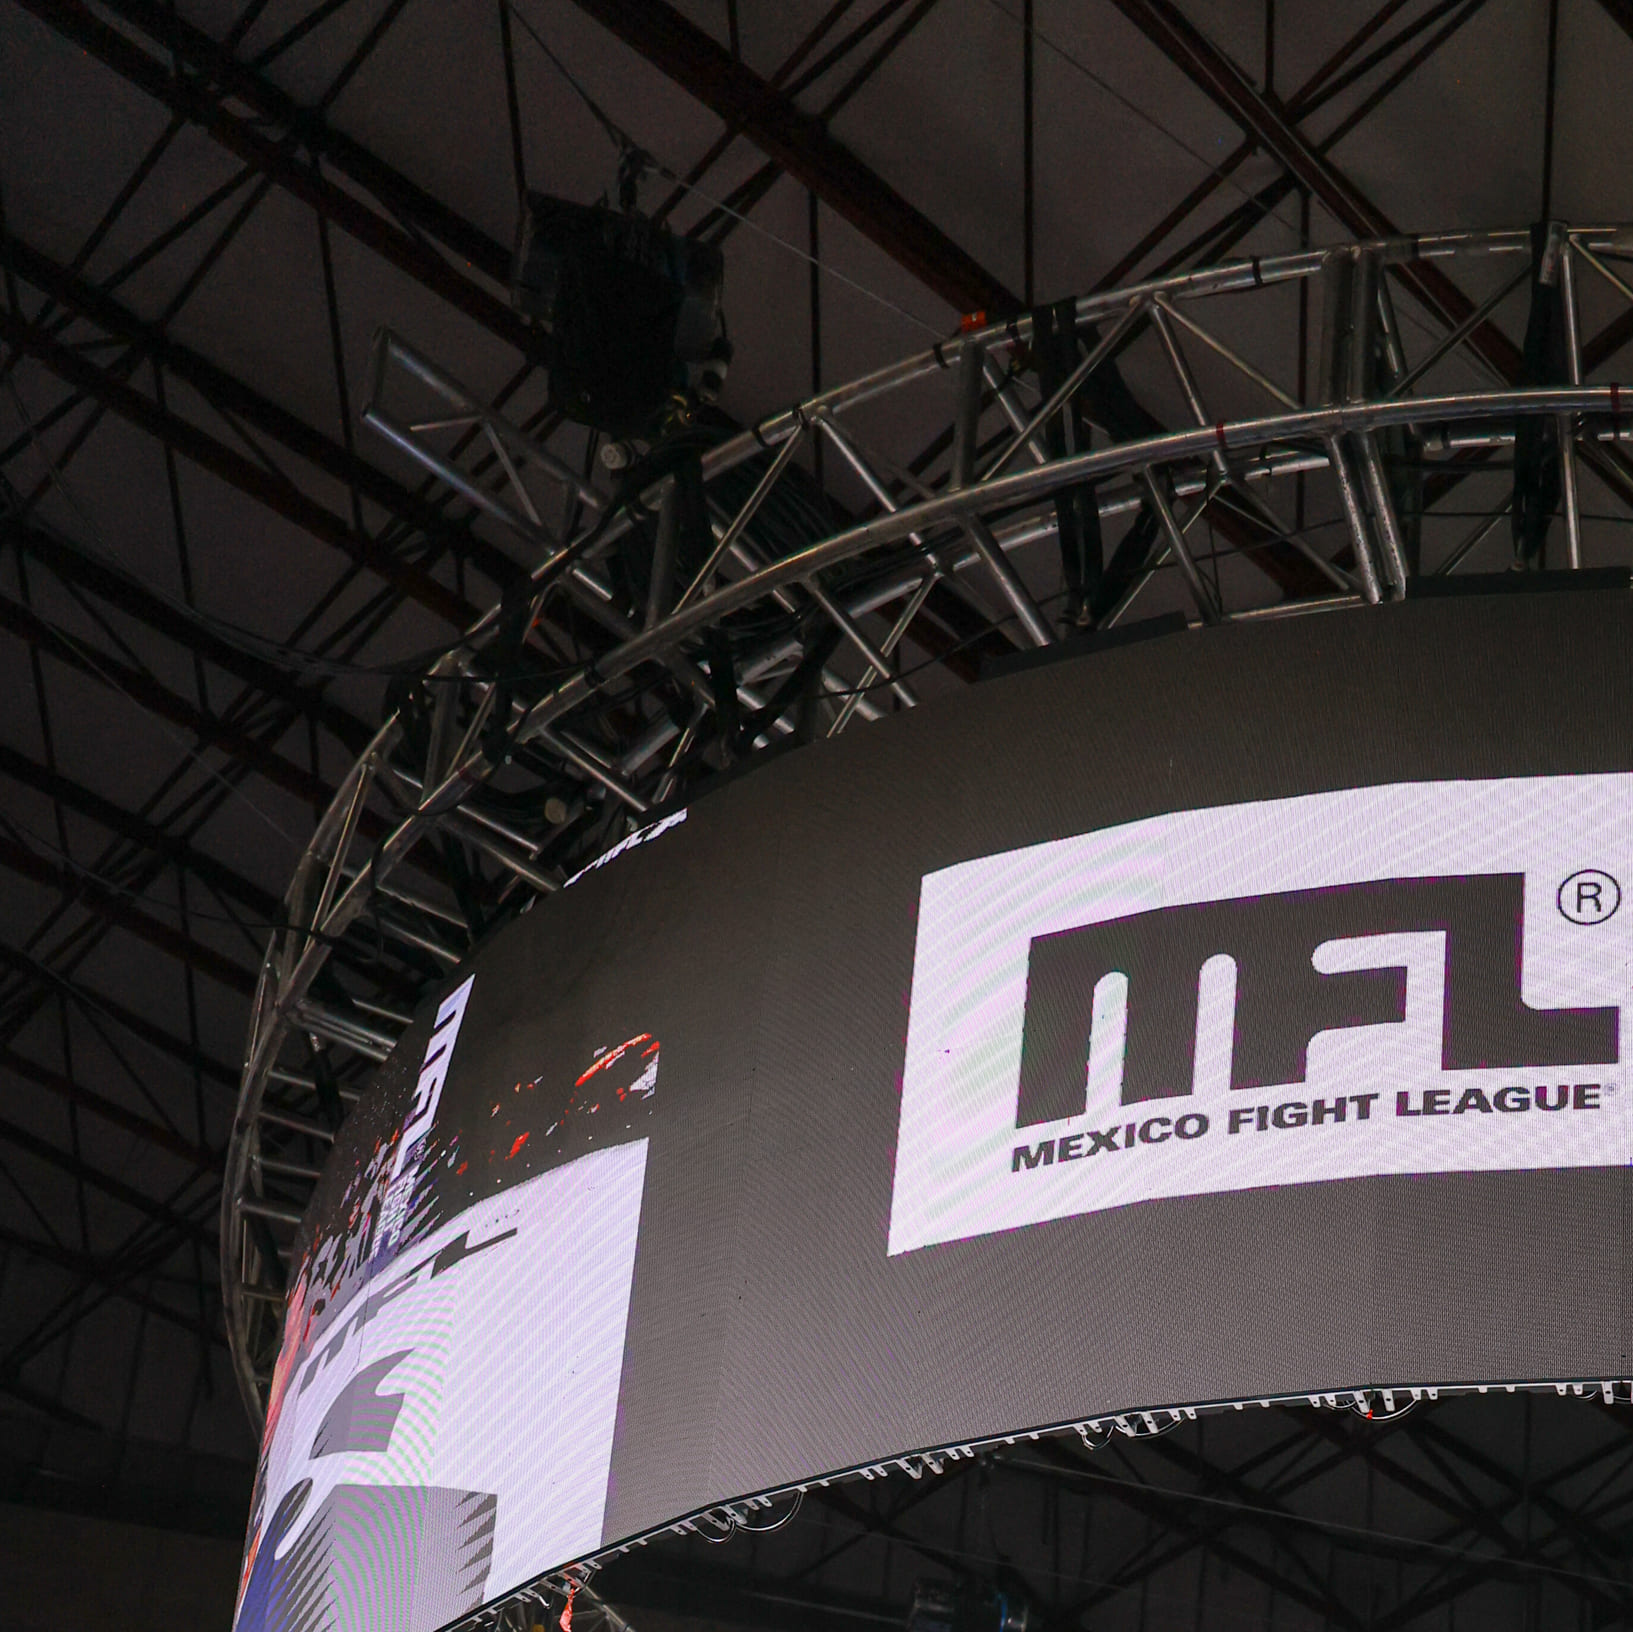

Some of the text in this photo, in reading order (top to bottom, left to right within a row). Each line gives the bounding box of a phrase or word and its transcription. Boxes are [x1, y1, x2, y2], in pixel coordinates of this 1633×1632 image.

[1014, 872, 1621, 1129] MFL
[1010, 1082, 1602, 1173] MEXICO FIGHT LEAGUE
